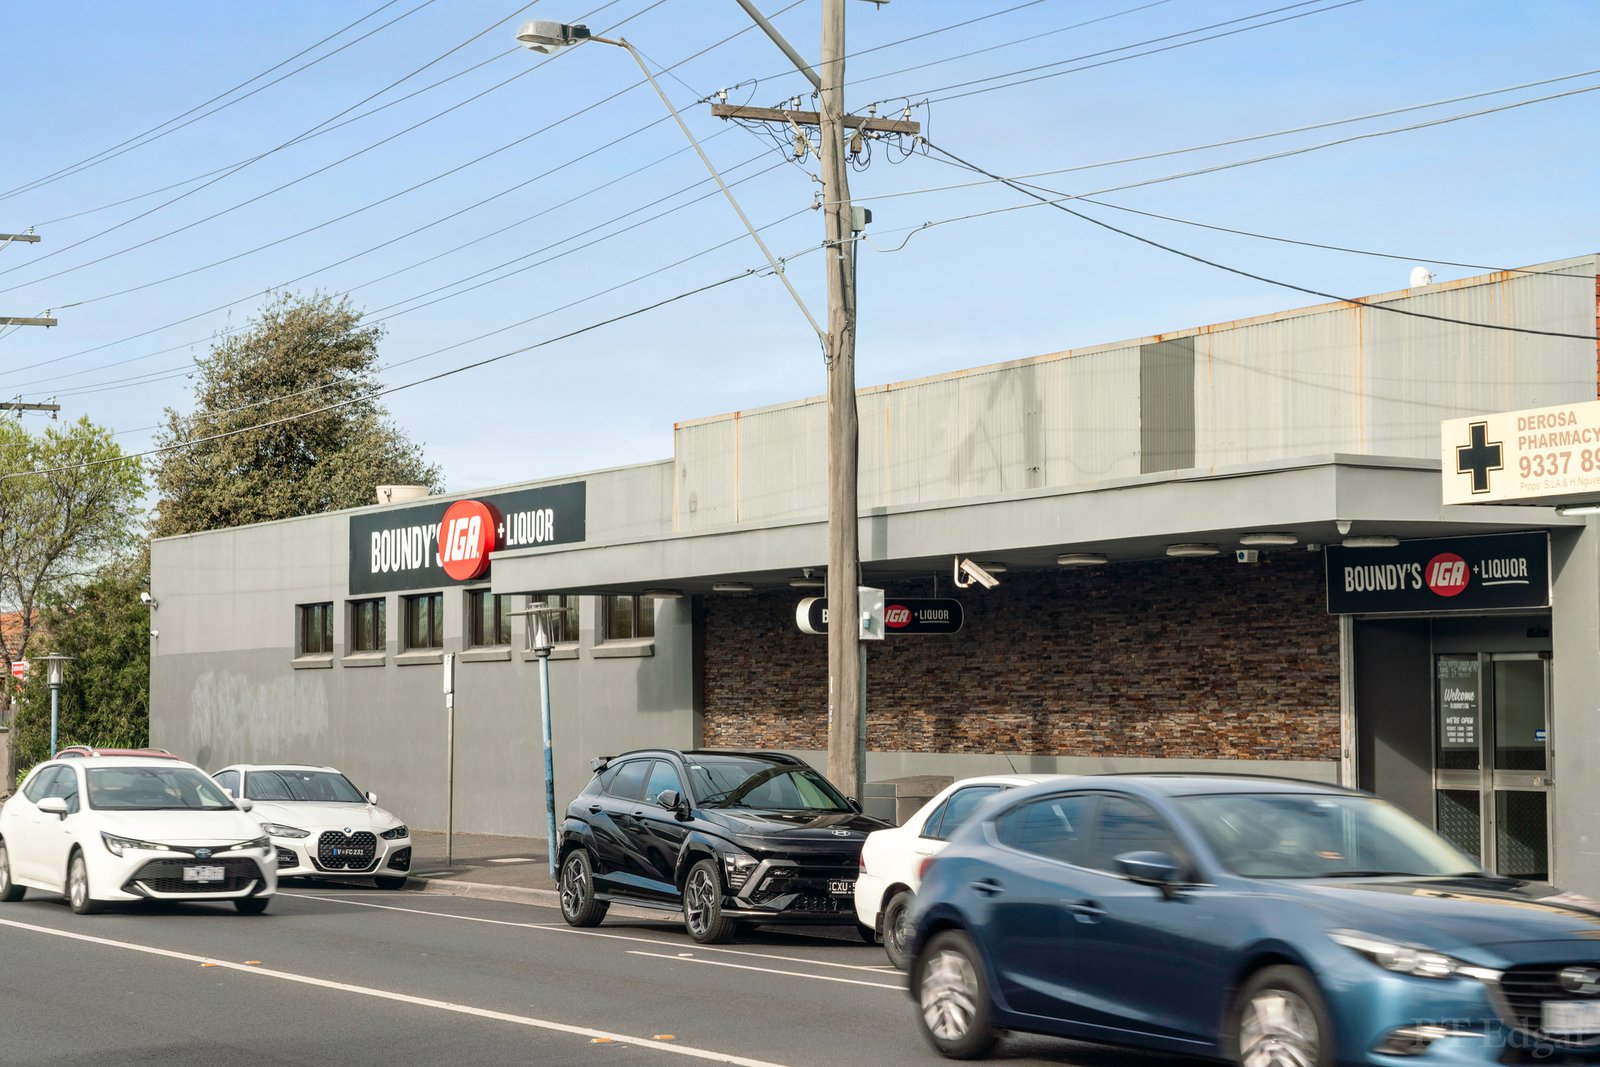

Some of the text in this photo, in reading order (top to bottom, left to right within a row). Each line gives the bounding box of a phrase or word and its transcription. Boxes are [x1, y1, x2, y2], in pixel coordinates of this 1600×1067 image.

[1517, 411, 1577, 432] DEROSA
[1518, 427, 1600, 451] PHARMACY
[1519, 451, 1572, 478] 9337
[444, 515, 481, 562] IGA
[506, 508, 554, 545] LIQUOR
[1344, 562, 1422, 592] BOUNDY'S
[1430, 561, 1465, 587] IGA
[1481, 558, 1528, 579] LIQUOR
[885, 609, 908, 623] IGA
[919, 609, 949, 620] LIQUOR
[1443, 687, 1475, 701] Welcome
[1460, 716, 1474, 724] OPEN
